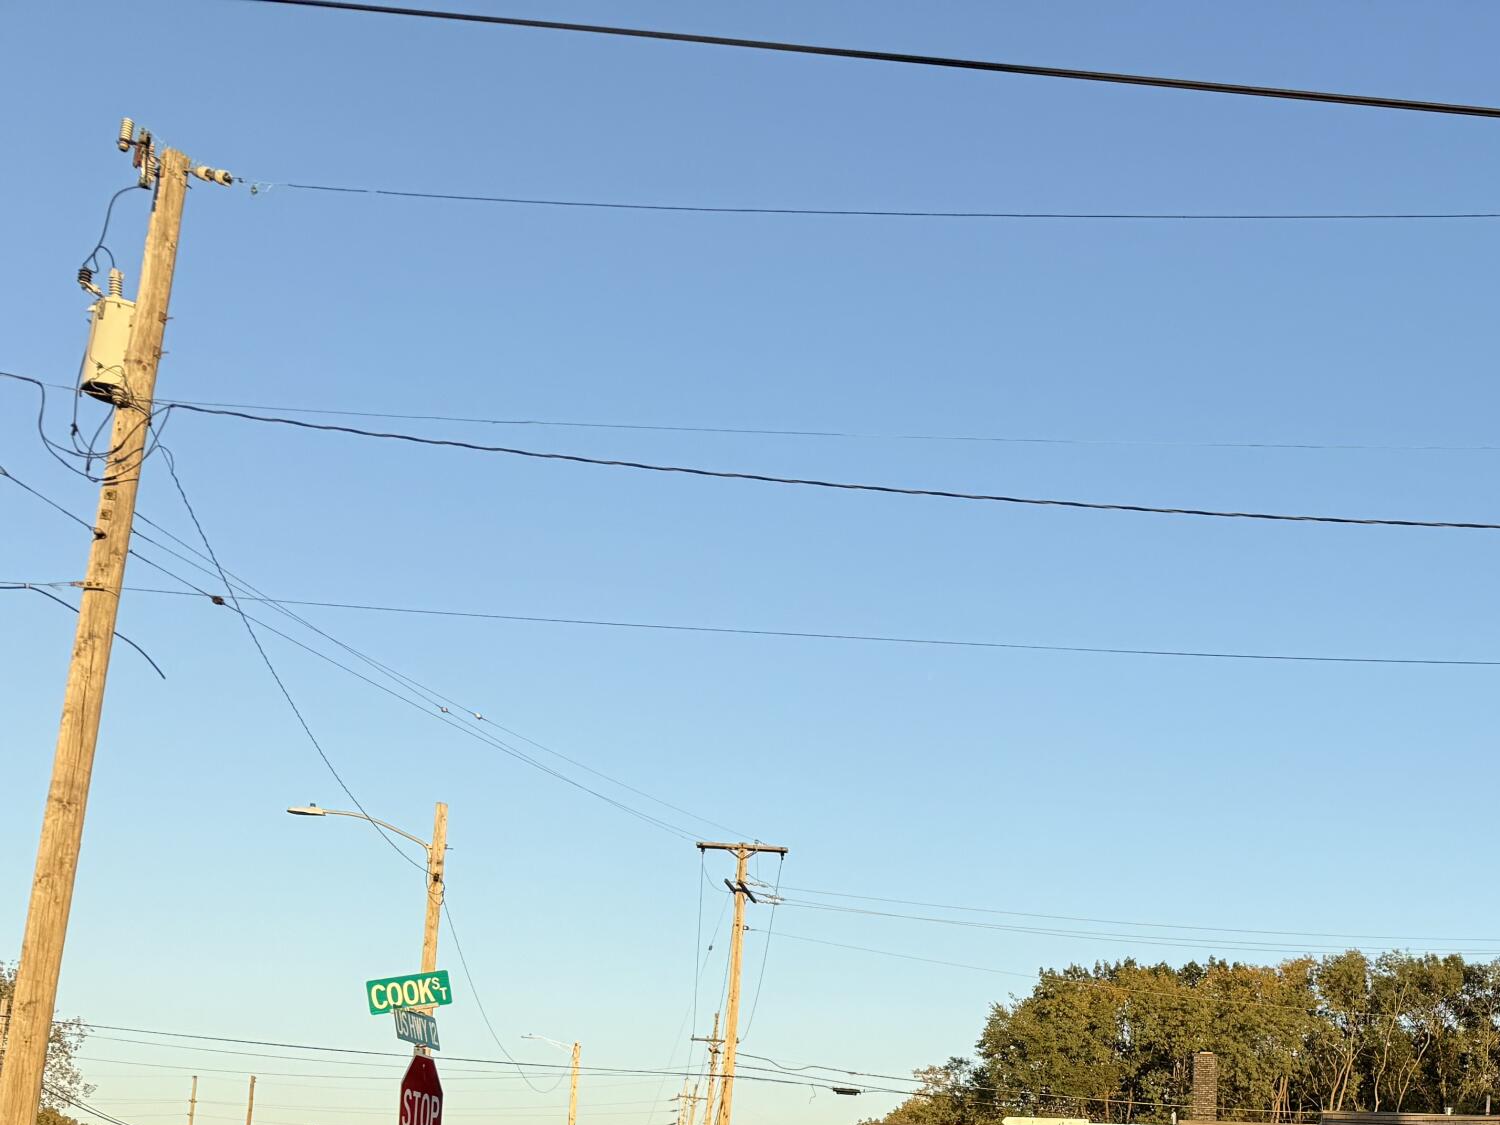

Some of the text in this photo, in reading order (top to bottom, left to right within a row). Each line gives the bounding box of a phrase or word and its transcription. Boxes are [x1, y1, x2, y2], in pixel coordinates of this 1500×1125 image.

[371, 977, 447, 1010] COOK ST
[395, 1009, 439, 1046] US HWY 12
